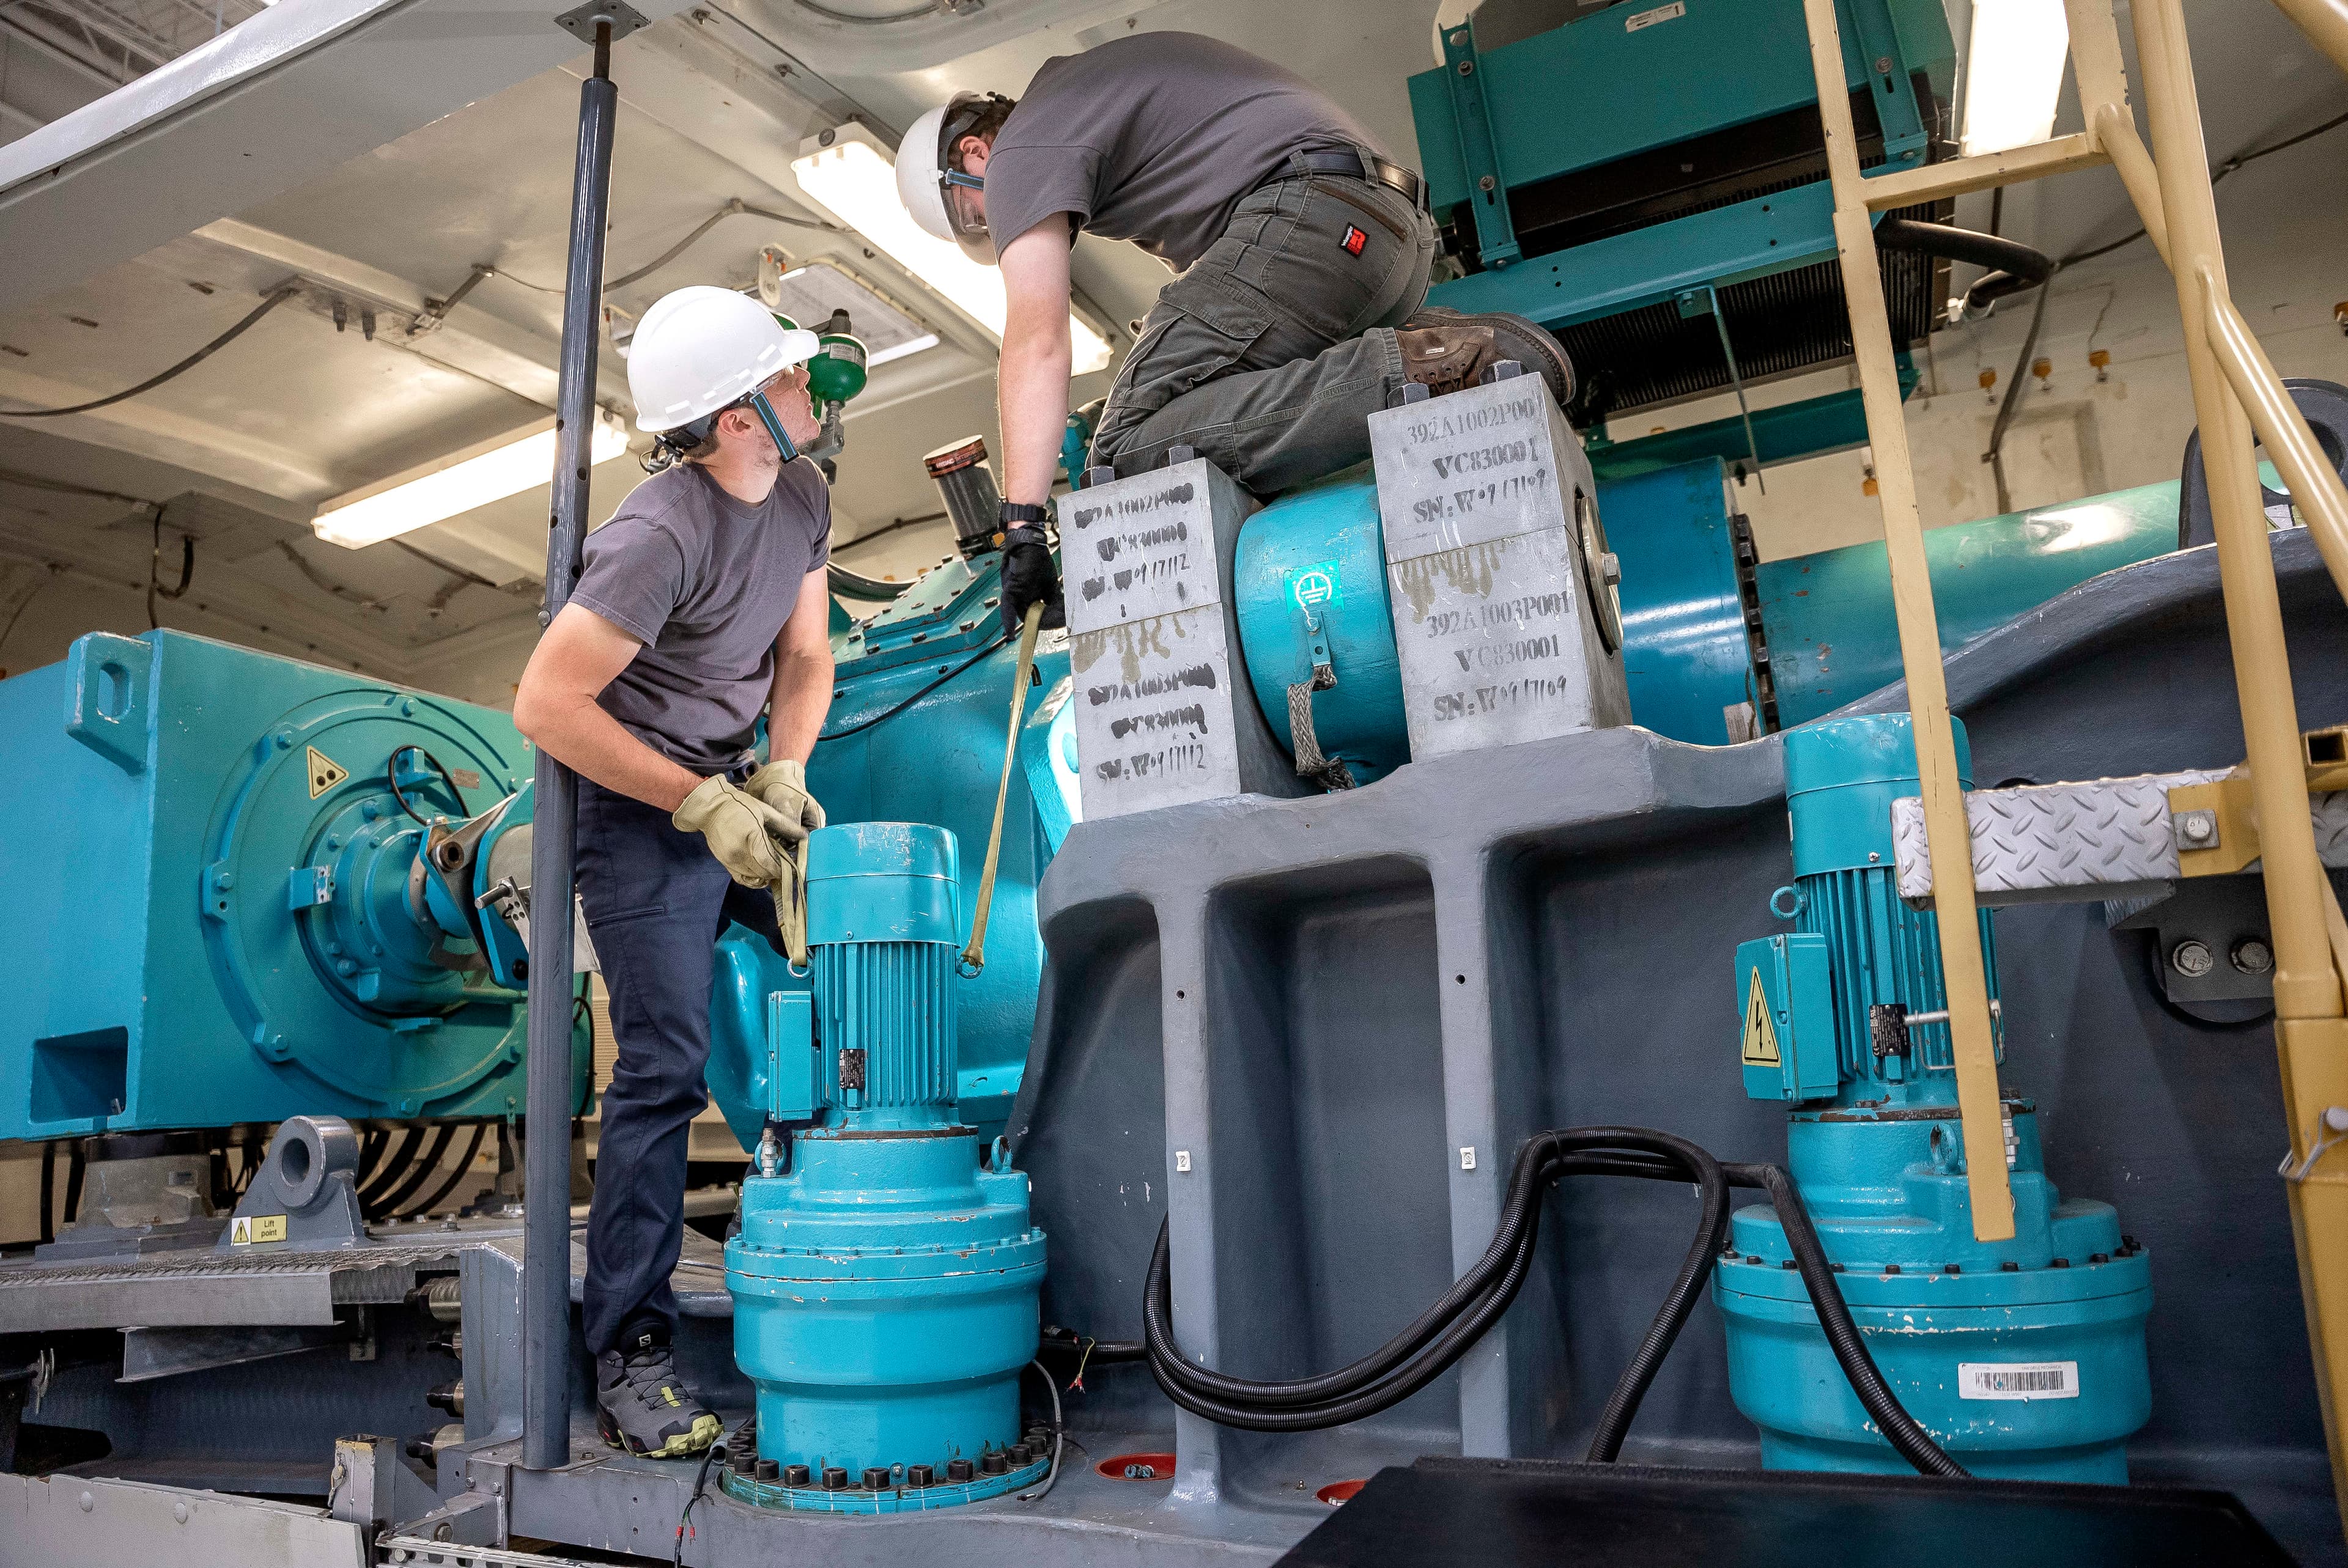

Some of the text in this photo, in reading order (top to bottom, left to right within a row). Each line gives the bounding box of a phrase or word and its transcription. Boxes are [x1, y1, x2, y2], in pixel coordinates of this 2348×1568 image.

[1341, 226, 1353, 246] Wrangler
[1432, 435, 1538, 479] VC830001
[1427, 591, 1570, 639] 392A1003P001
[1453, 634, 1560, 672] VC830001
[261, 1229, 277, 1239] point
